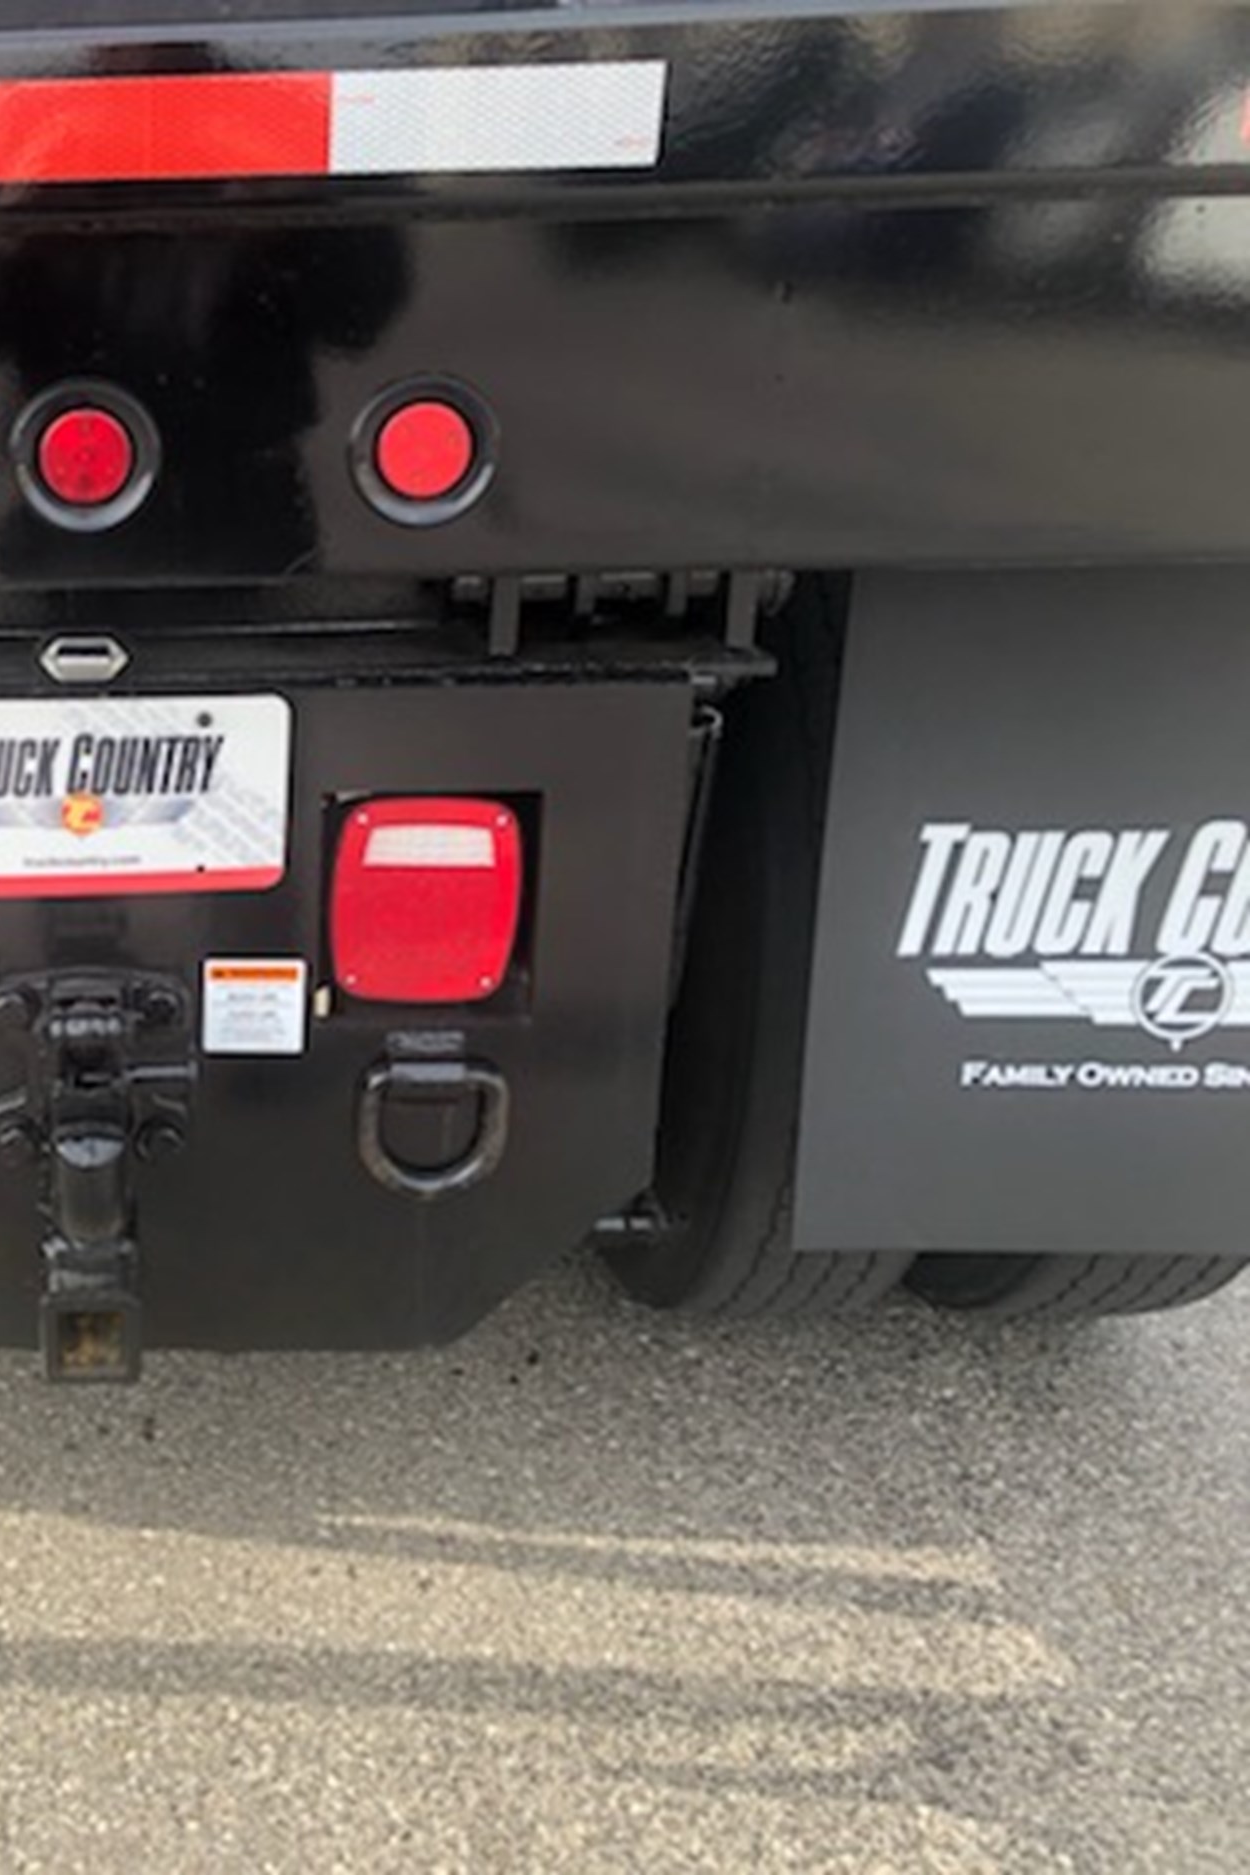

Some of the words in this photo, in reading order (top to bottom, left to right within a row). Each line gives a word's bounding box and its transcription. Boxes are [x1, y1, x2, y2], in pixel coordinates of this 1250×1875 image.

[66, 732, 224, 796] COUNTRY
[897, 823, 1170, 957] TRUCK
[961, 1061, 1075, 1087] FAMILY
[1076, 1062, 1199, 1087] OWNED
